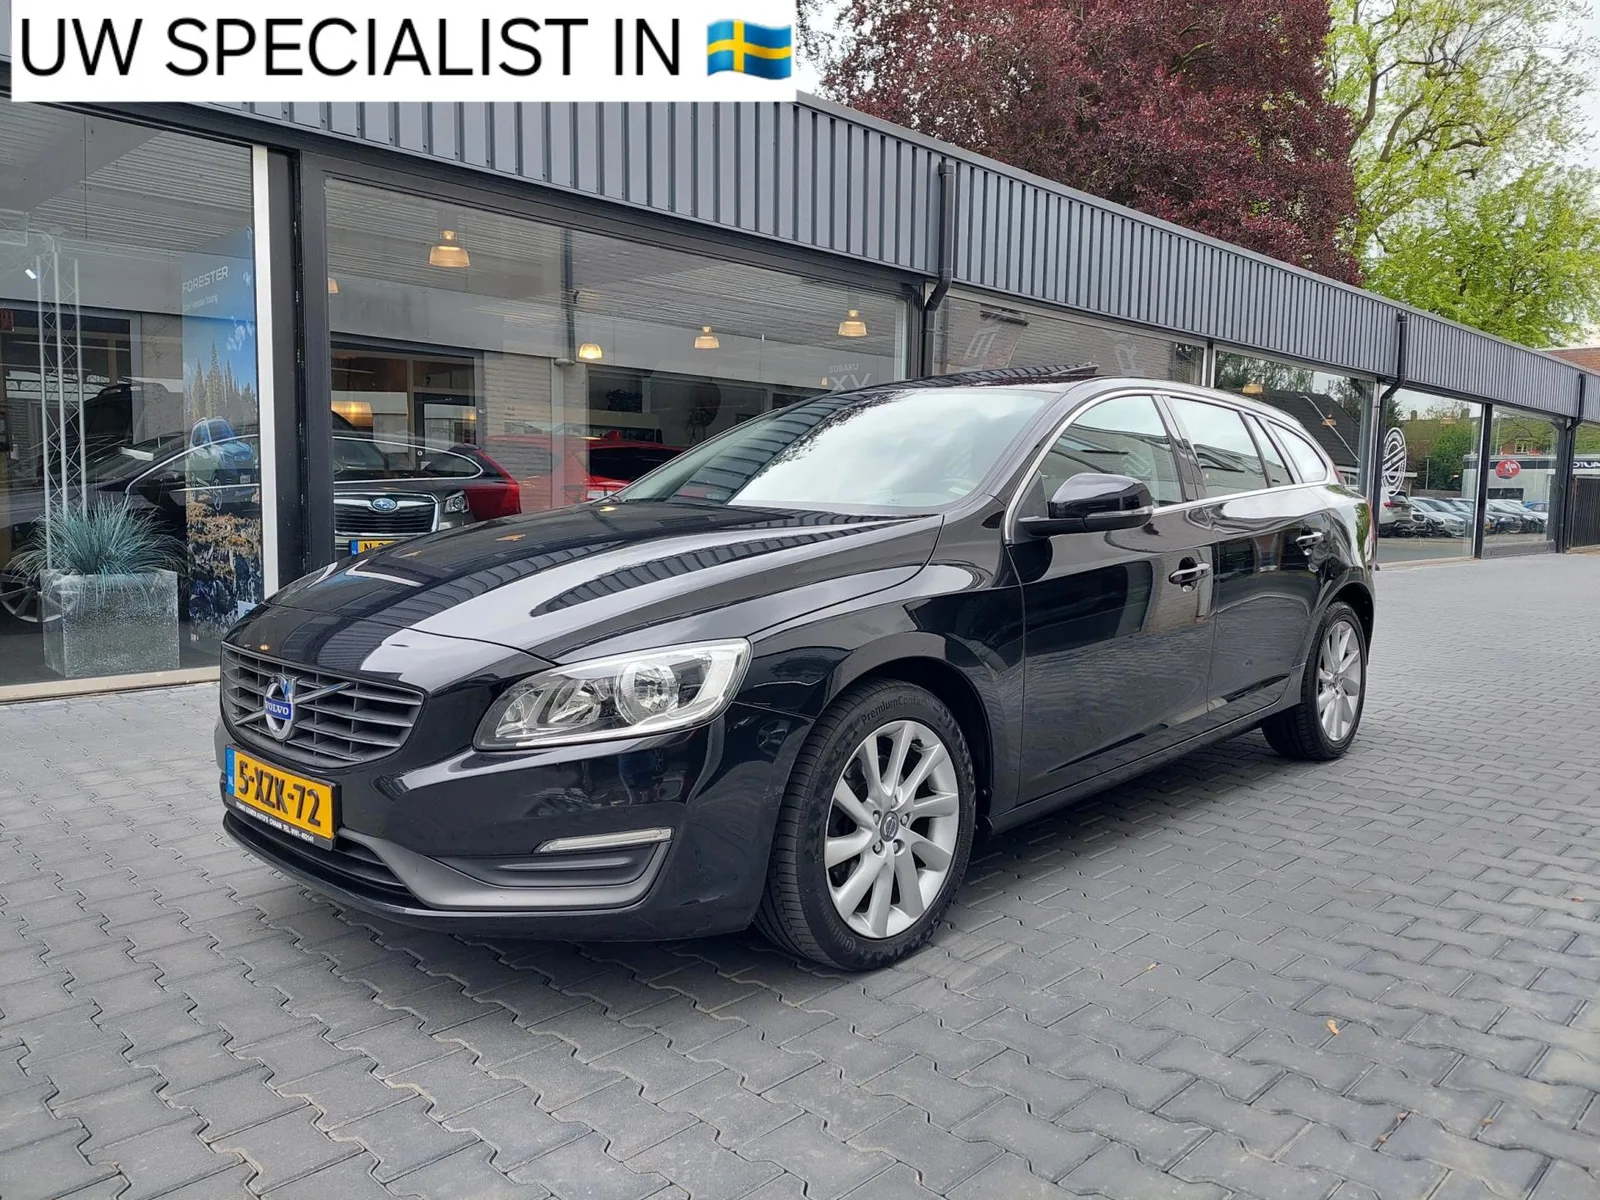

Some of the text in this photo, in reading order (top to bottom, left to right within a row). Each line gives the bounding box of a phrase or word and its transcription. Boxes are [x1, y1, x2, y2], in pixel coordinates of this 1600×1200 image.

[182, 265, 228, 293] FORESTER
[828, 363, 859, 373] SUBARU
[265, 700, 290, 716] VOLVO
[238, 760, 321, 828] 5-XZK-72
